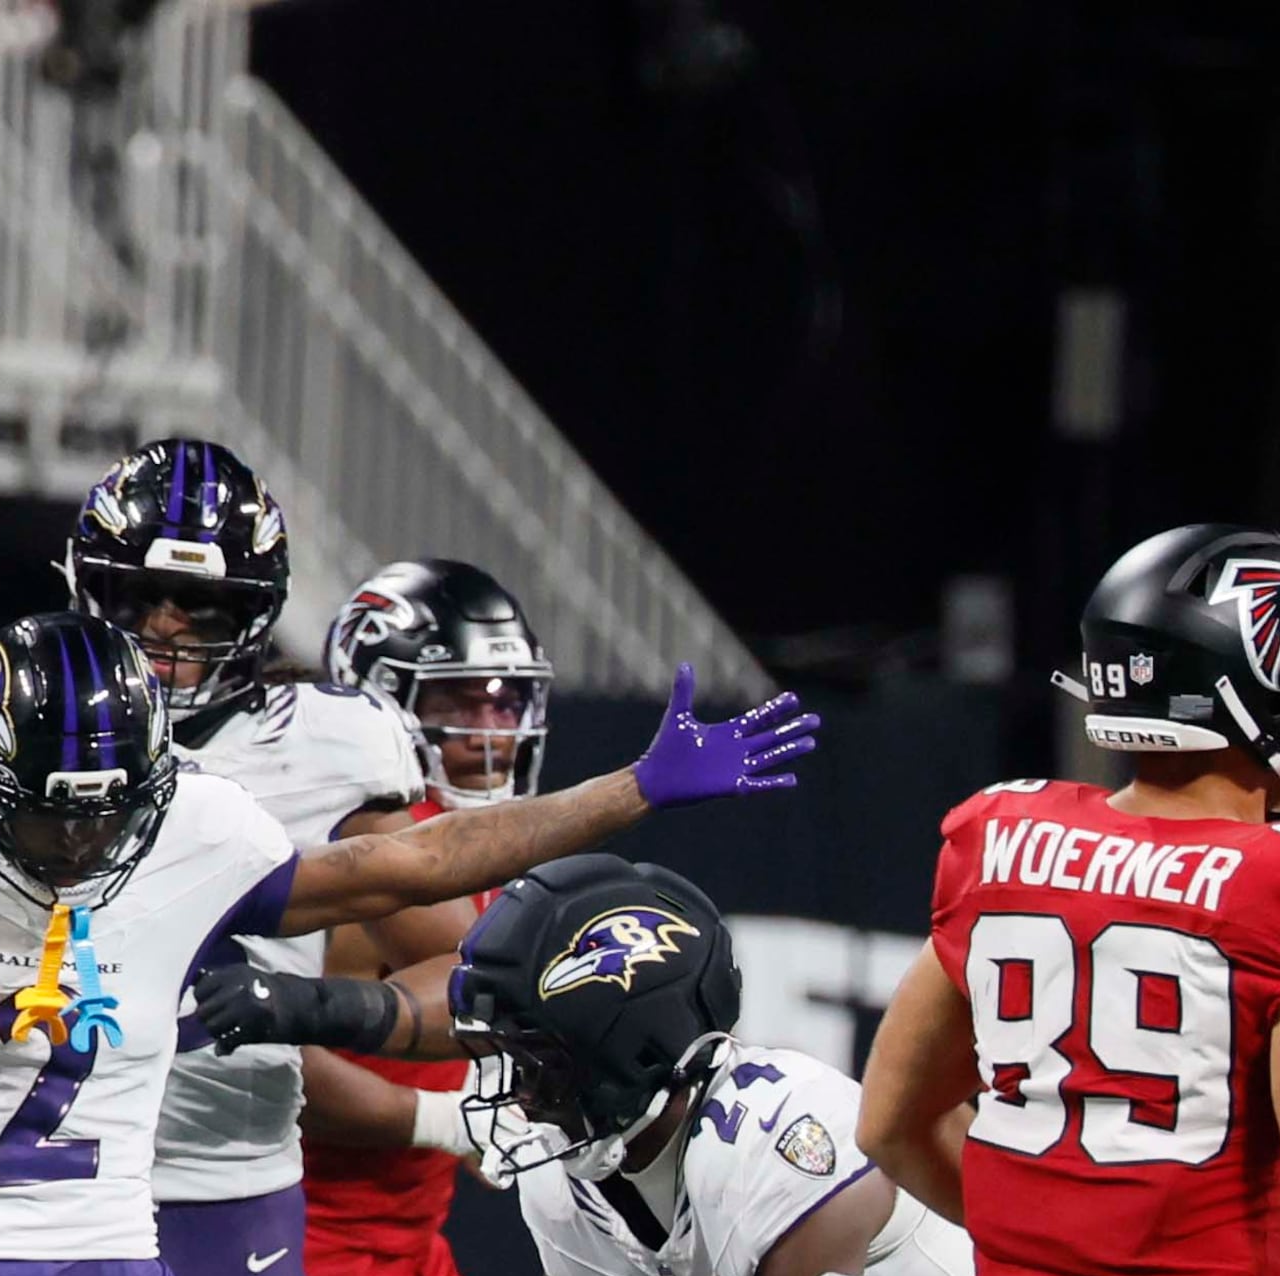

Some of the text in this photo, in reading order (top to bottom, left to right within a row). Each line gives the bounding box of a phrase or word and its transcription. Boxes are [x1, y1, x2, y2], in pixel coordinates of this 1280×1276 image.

[1090, 661, 1126, 698] 89
[981, 818, 1243, 912] WOERNER
[964, 911, 1234, 1167] 89
